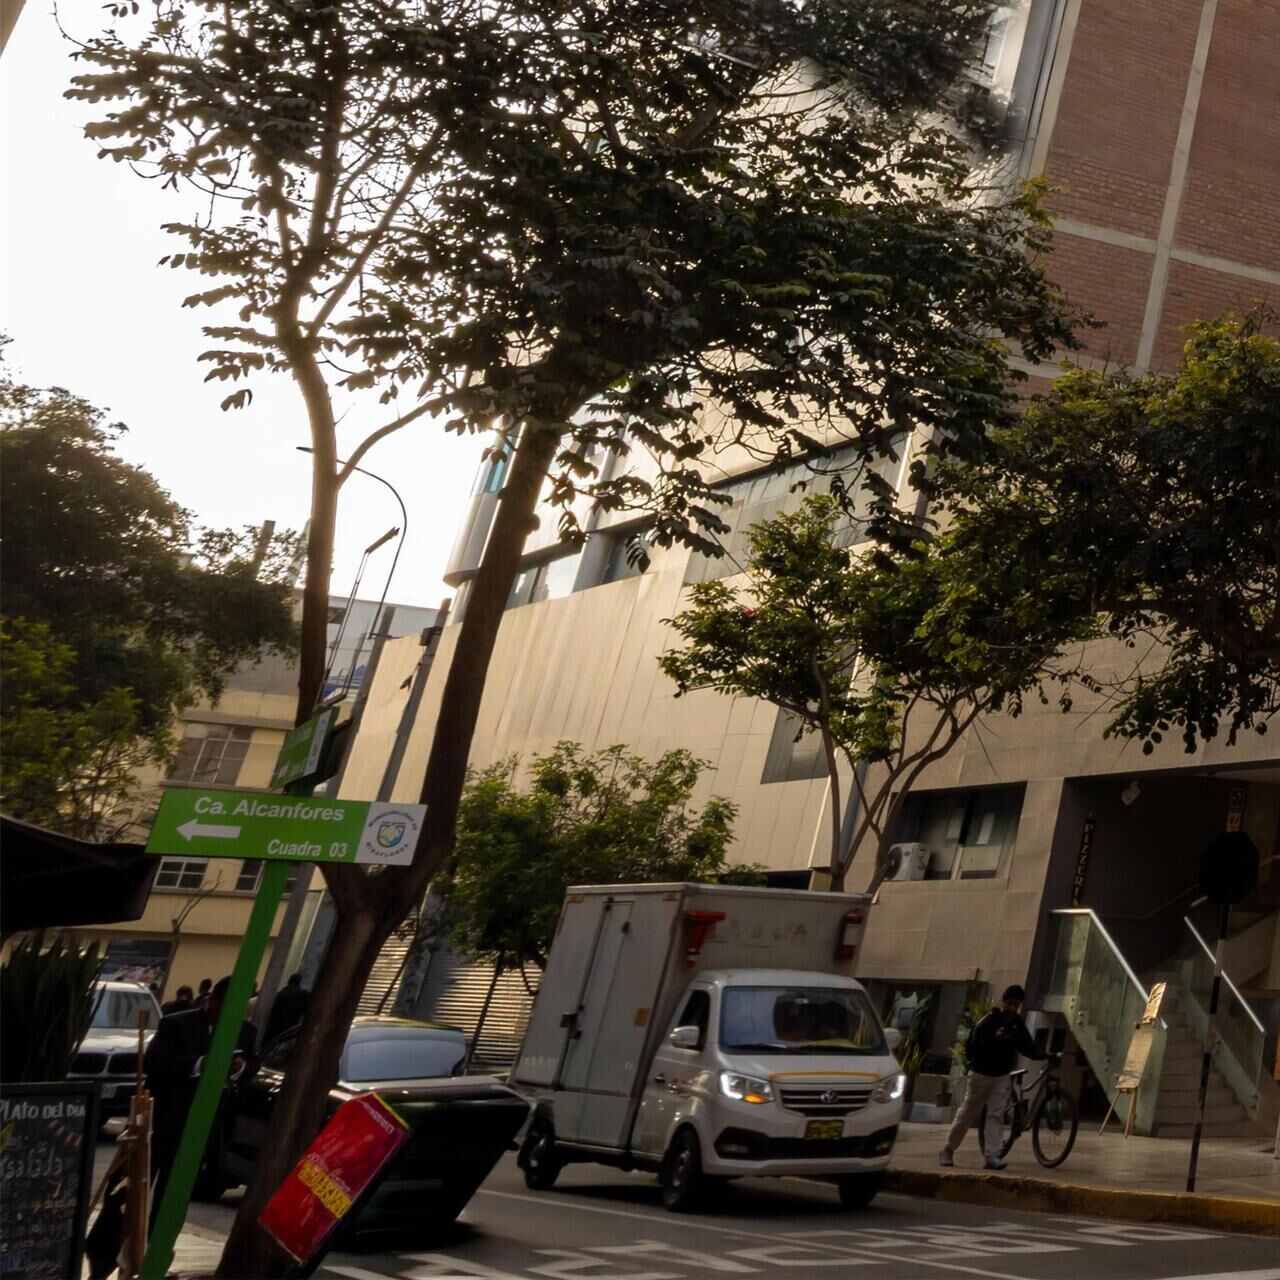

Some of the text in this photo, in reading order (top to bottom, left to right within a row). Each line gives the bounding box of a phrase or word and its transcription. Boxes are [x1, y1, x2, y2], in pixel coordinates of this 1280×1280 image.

[194, 796, 345, 821] Ca. Alcanfores
[267, 838, 348, 858] Cuadra 03
